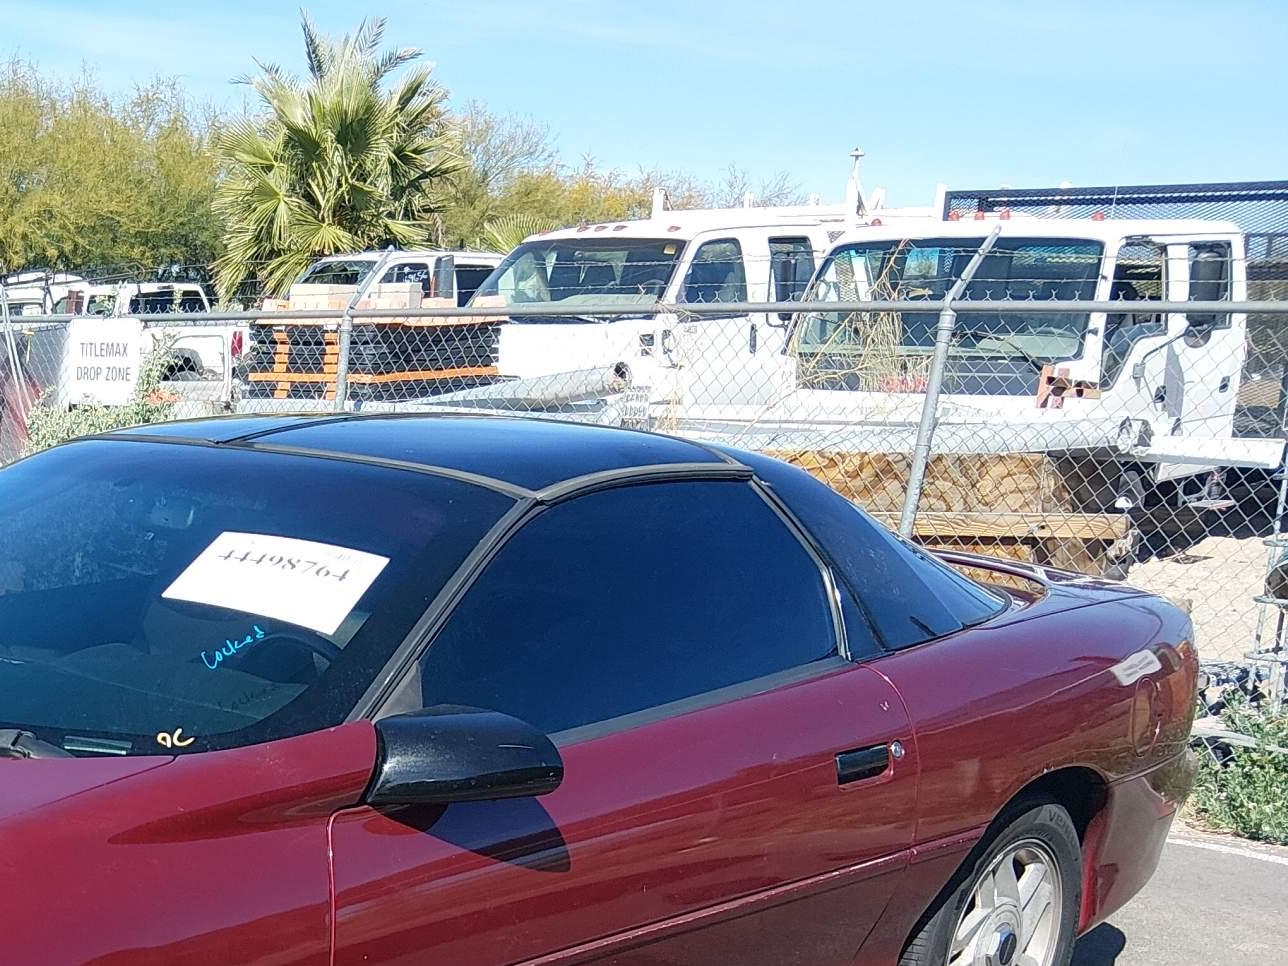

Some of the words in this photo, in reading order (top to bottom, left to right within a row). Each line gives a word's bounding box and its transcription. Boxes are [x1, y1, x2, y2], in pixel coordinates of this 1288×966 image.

[80, 342, 129, 358] TITLEMAX
[76, 366, 102, 381] DROP
[105, 367, 131, 382] ZONE
[217, 549, 350, 583] 44498764
